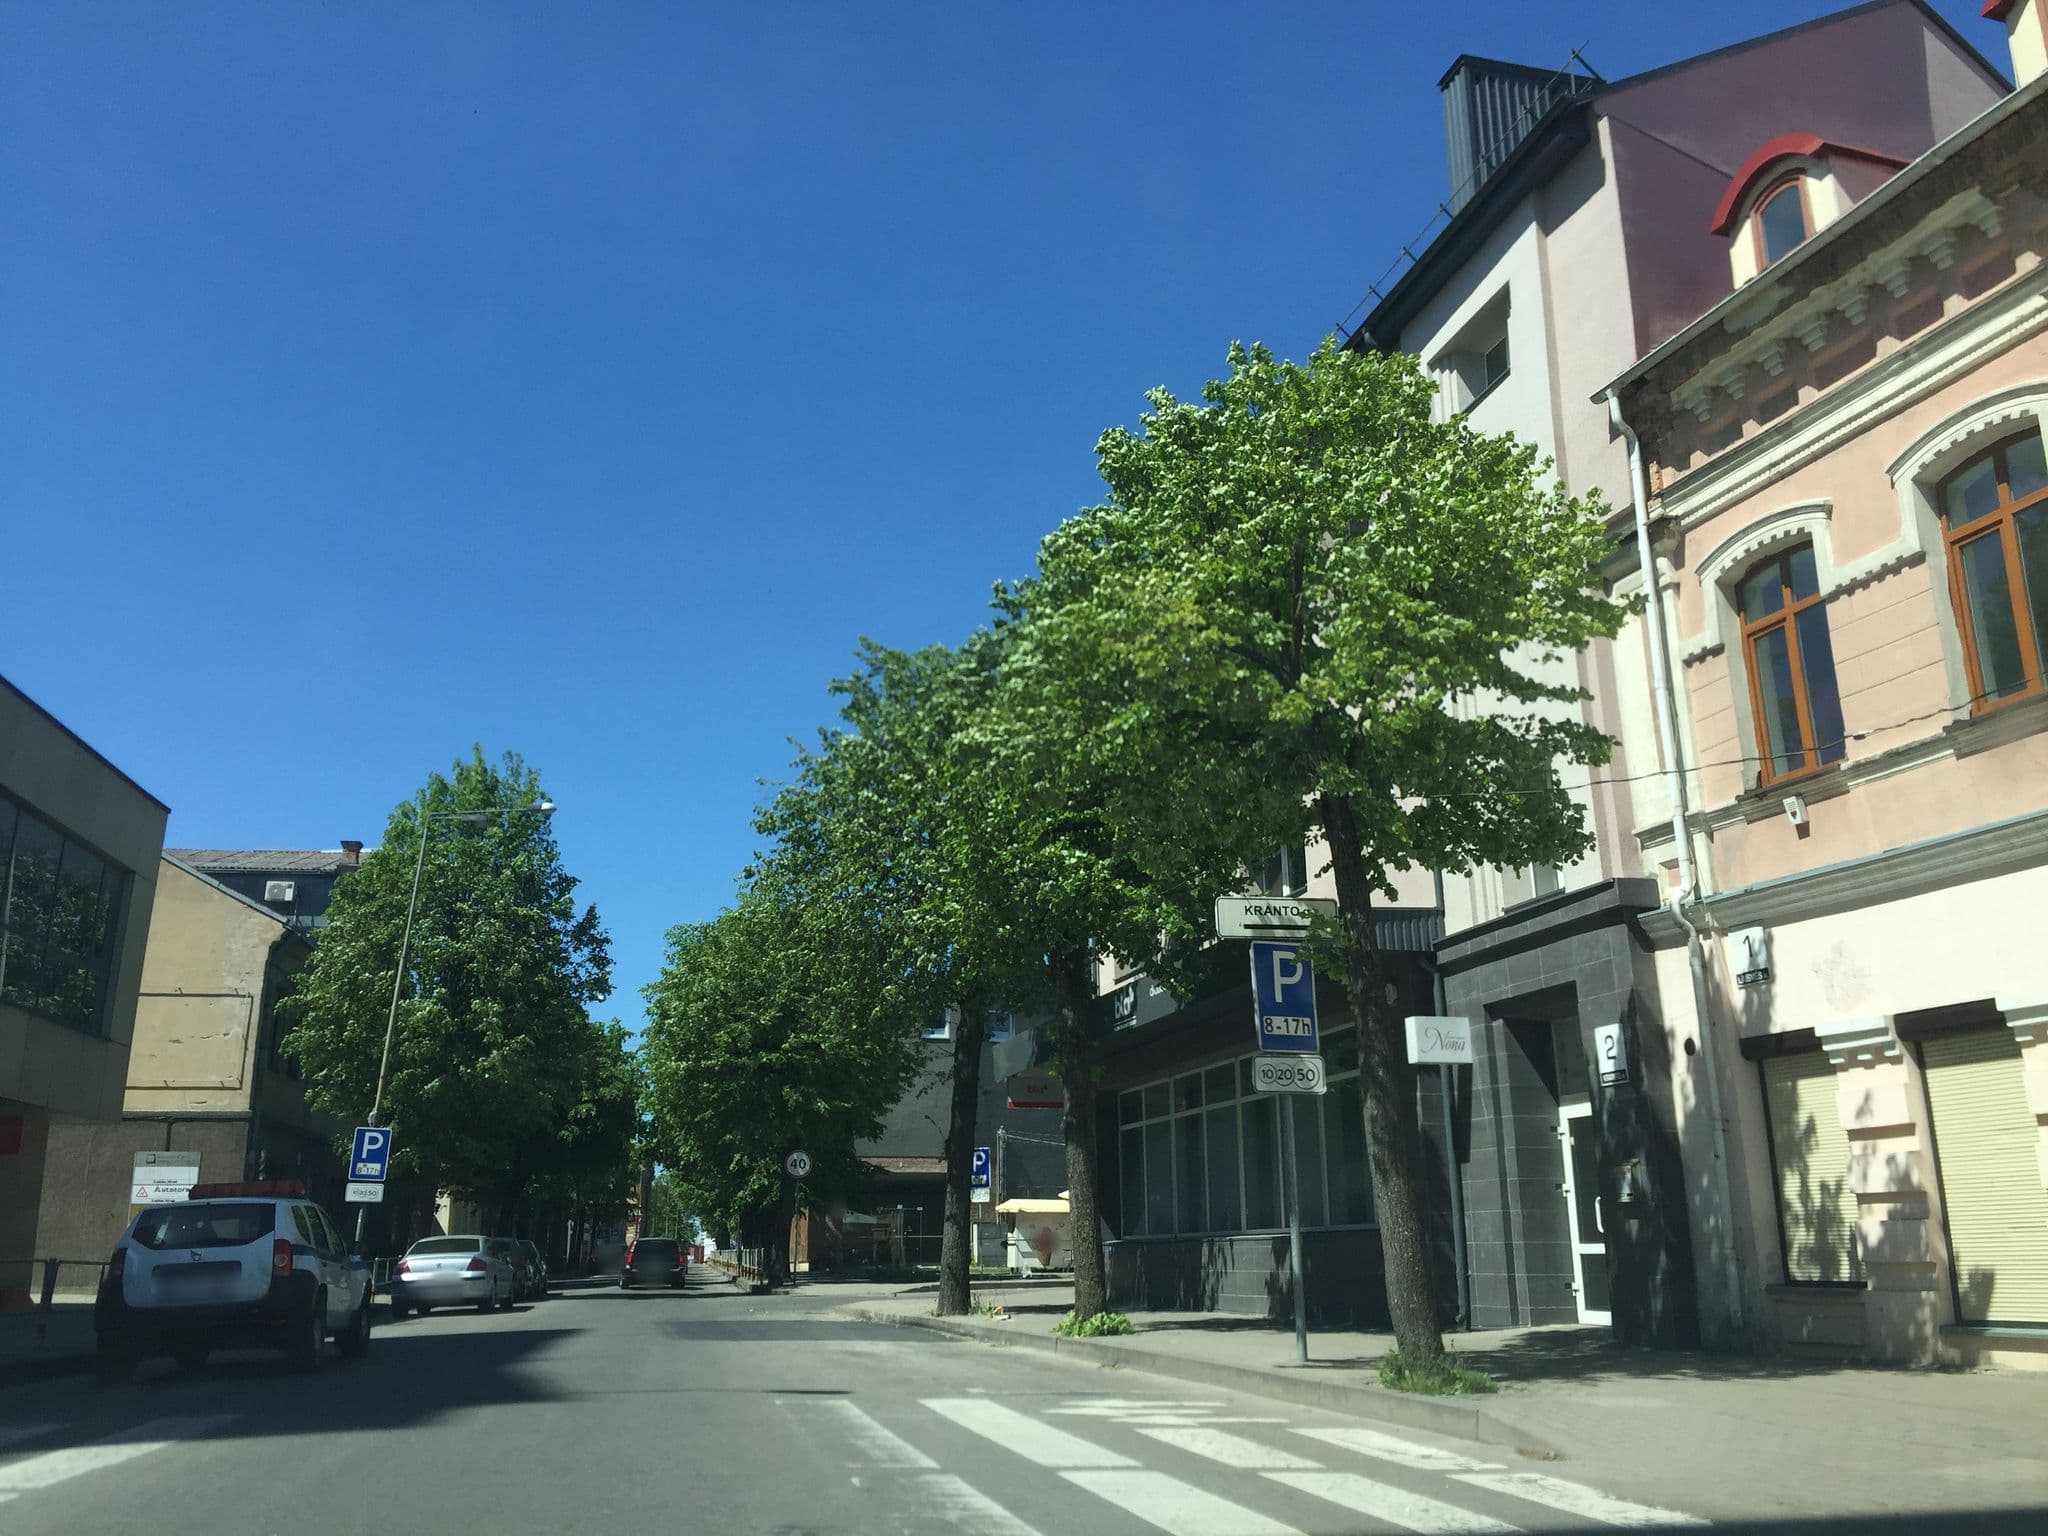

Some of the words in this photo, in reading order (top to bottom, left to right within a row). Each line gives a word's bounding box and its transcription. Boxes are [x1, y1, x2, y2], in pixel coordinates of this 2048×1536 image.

[1244, 905, 1300, 917] KRANTO
[1743, 935, 1753, 958] 1
[1272, 950, 1303, 1003] P
[1420, 1025, 1466, 1053] Nona
[1604, 1034, 1617, 1060] 2
[1261, 1069, 1274, 1080] 10
[1277, 1069, 1293, 1081] 20
[1297, 1069, 1316, 1082] 50
[361, 1131, 384, 1159] P
[790, 1158, 807, 1170] 40
[973, 1150, 986, 1172] P
